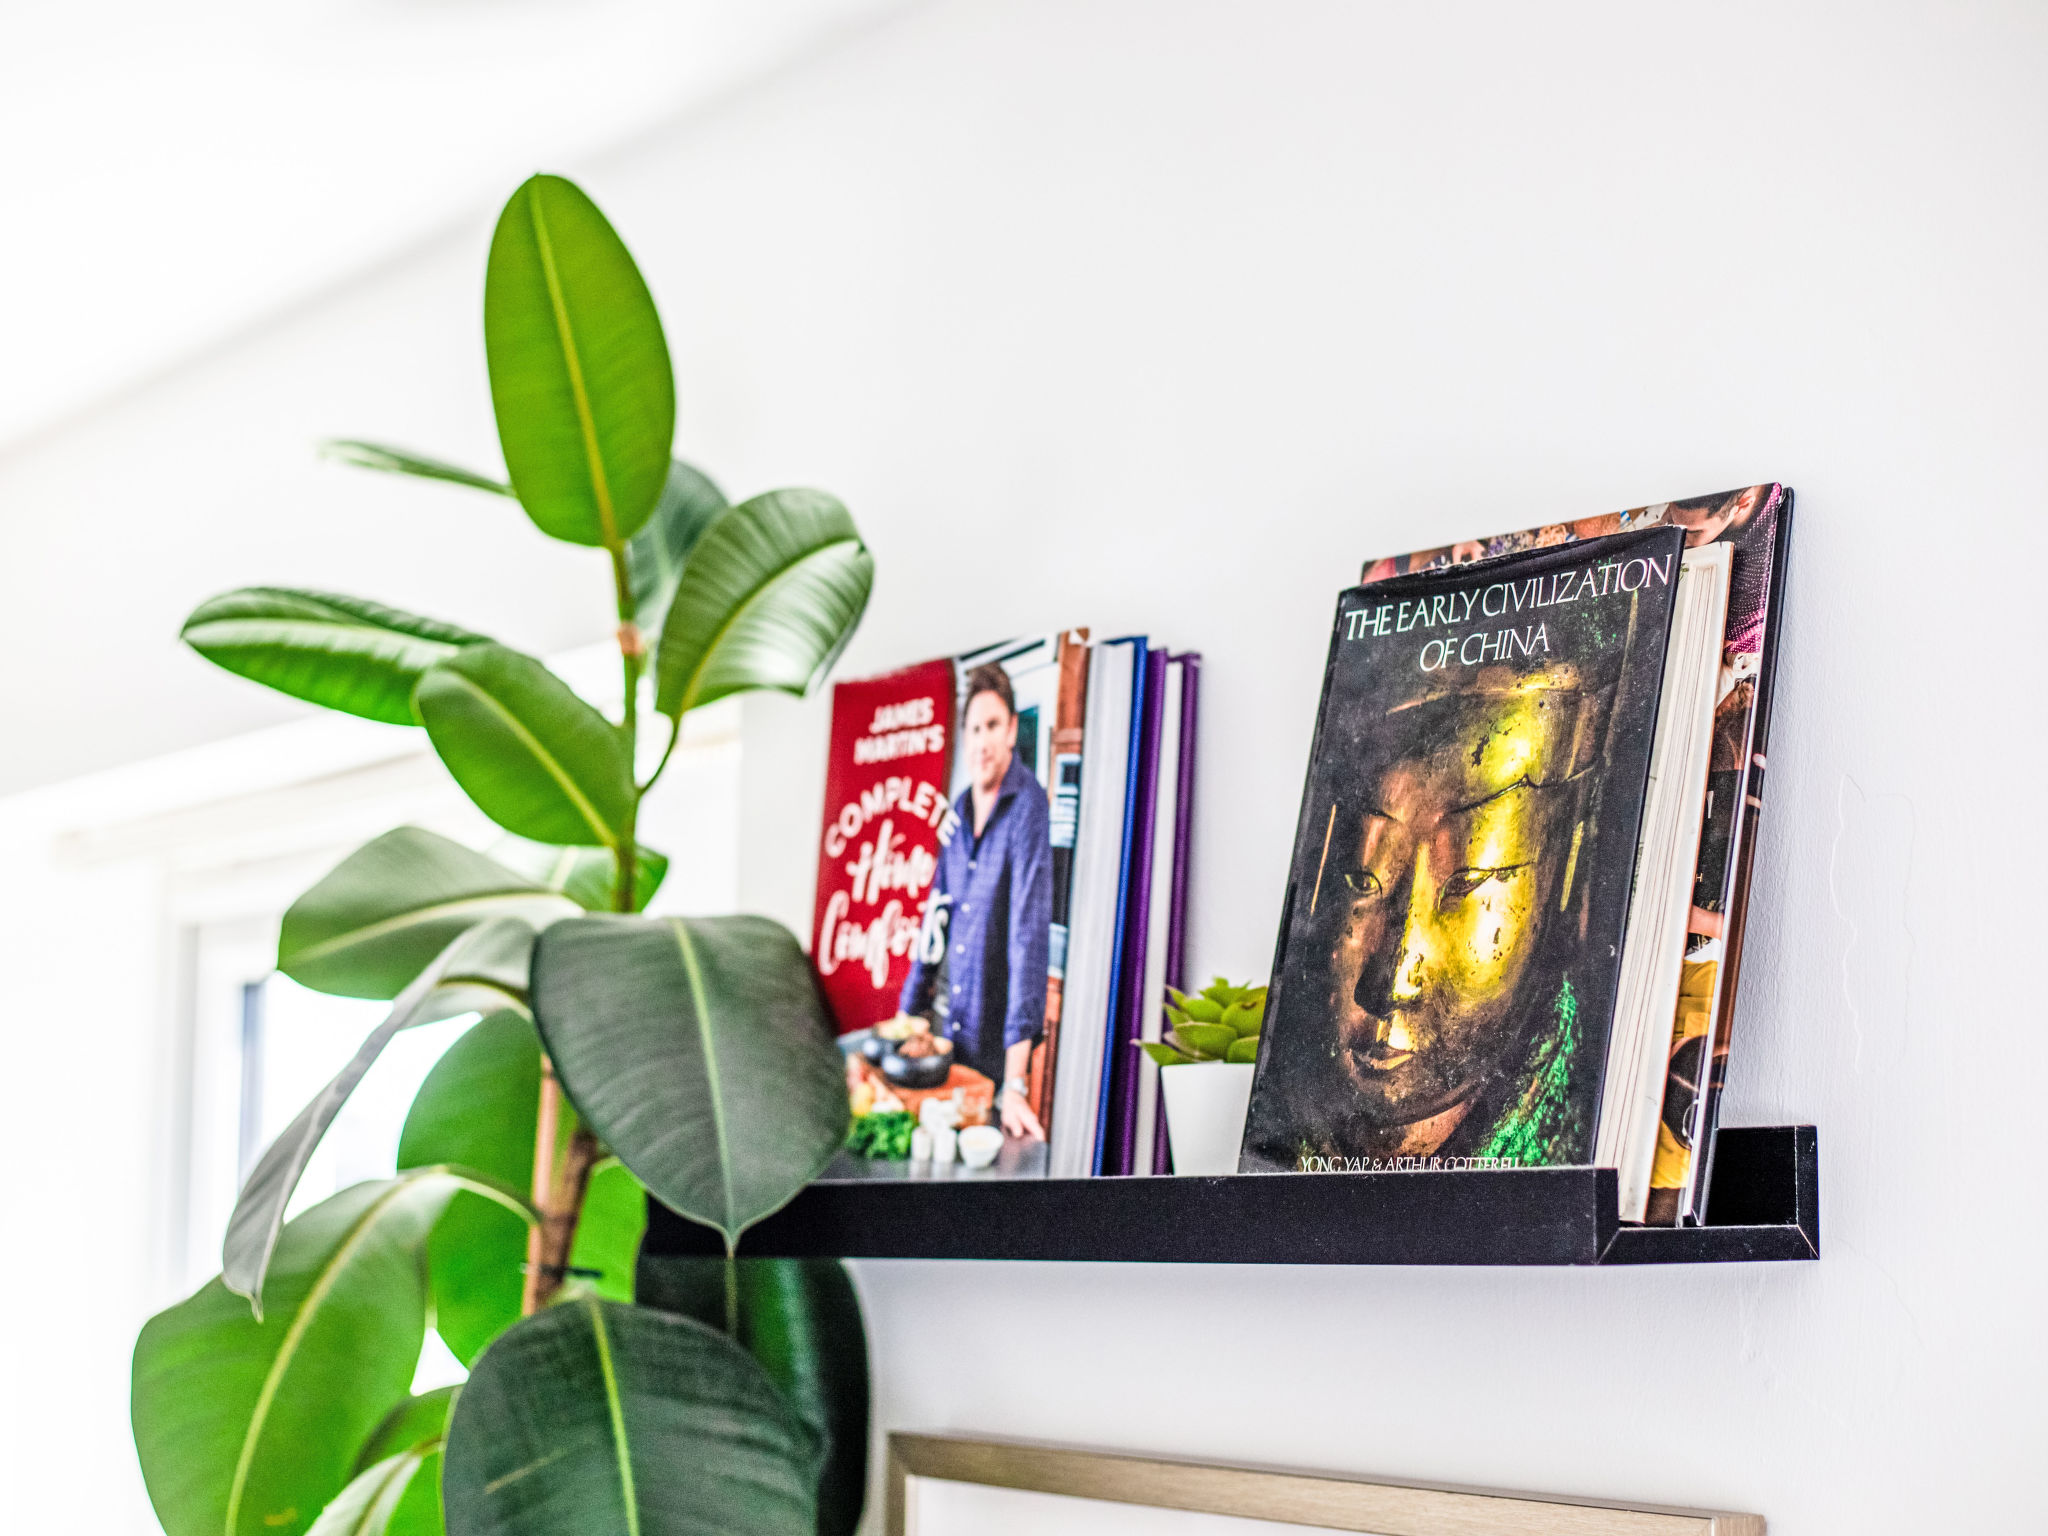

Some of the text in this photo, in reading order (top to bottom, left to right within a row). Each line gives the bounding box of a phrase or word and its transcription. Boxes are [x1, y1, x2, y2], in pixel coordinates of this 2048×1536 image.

[1344, 554, 1672, 641] THE EARLY CIVILIZATION
[1419, 622, 1550, 672] OF CHINA
[869, 697, 934, 734] JAMES
[854, 724, 945, 765] MARTIN'S
[825, 777, 961, 857] COMPLETE
[1301, 1156, 1341, 1172] YONG
[1344, 1156, 1370, 1172] YAP
[1372, 1158, 1383, 1172] &
[1384, 1156, 1440, 1171] ARTHUR
